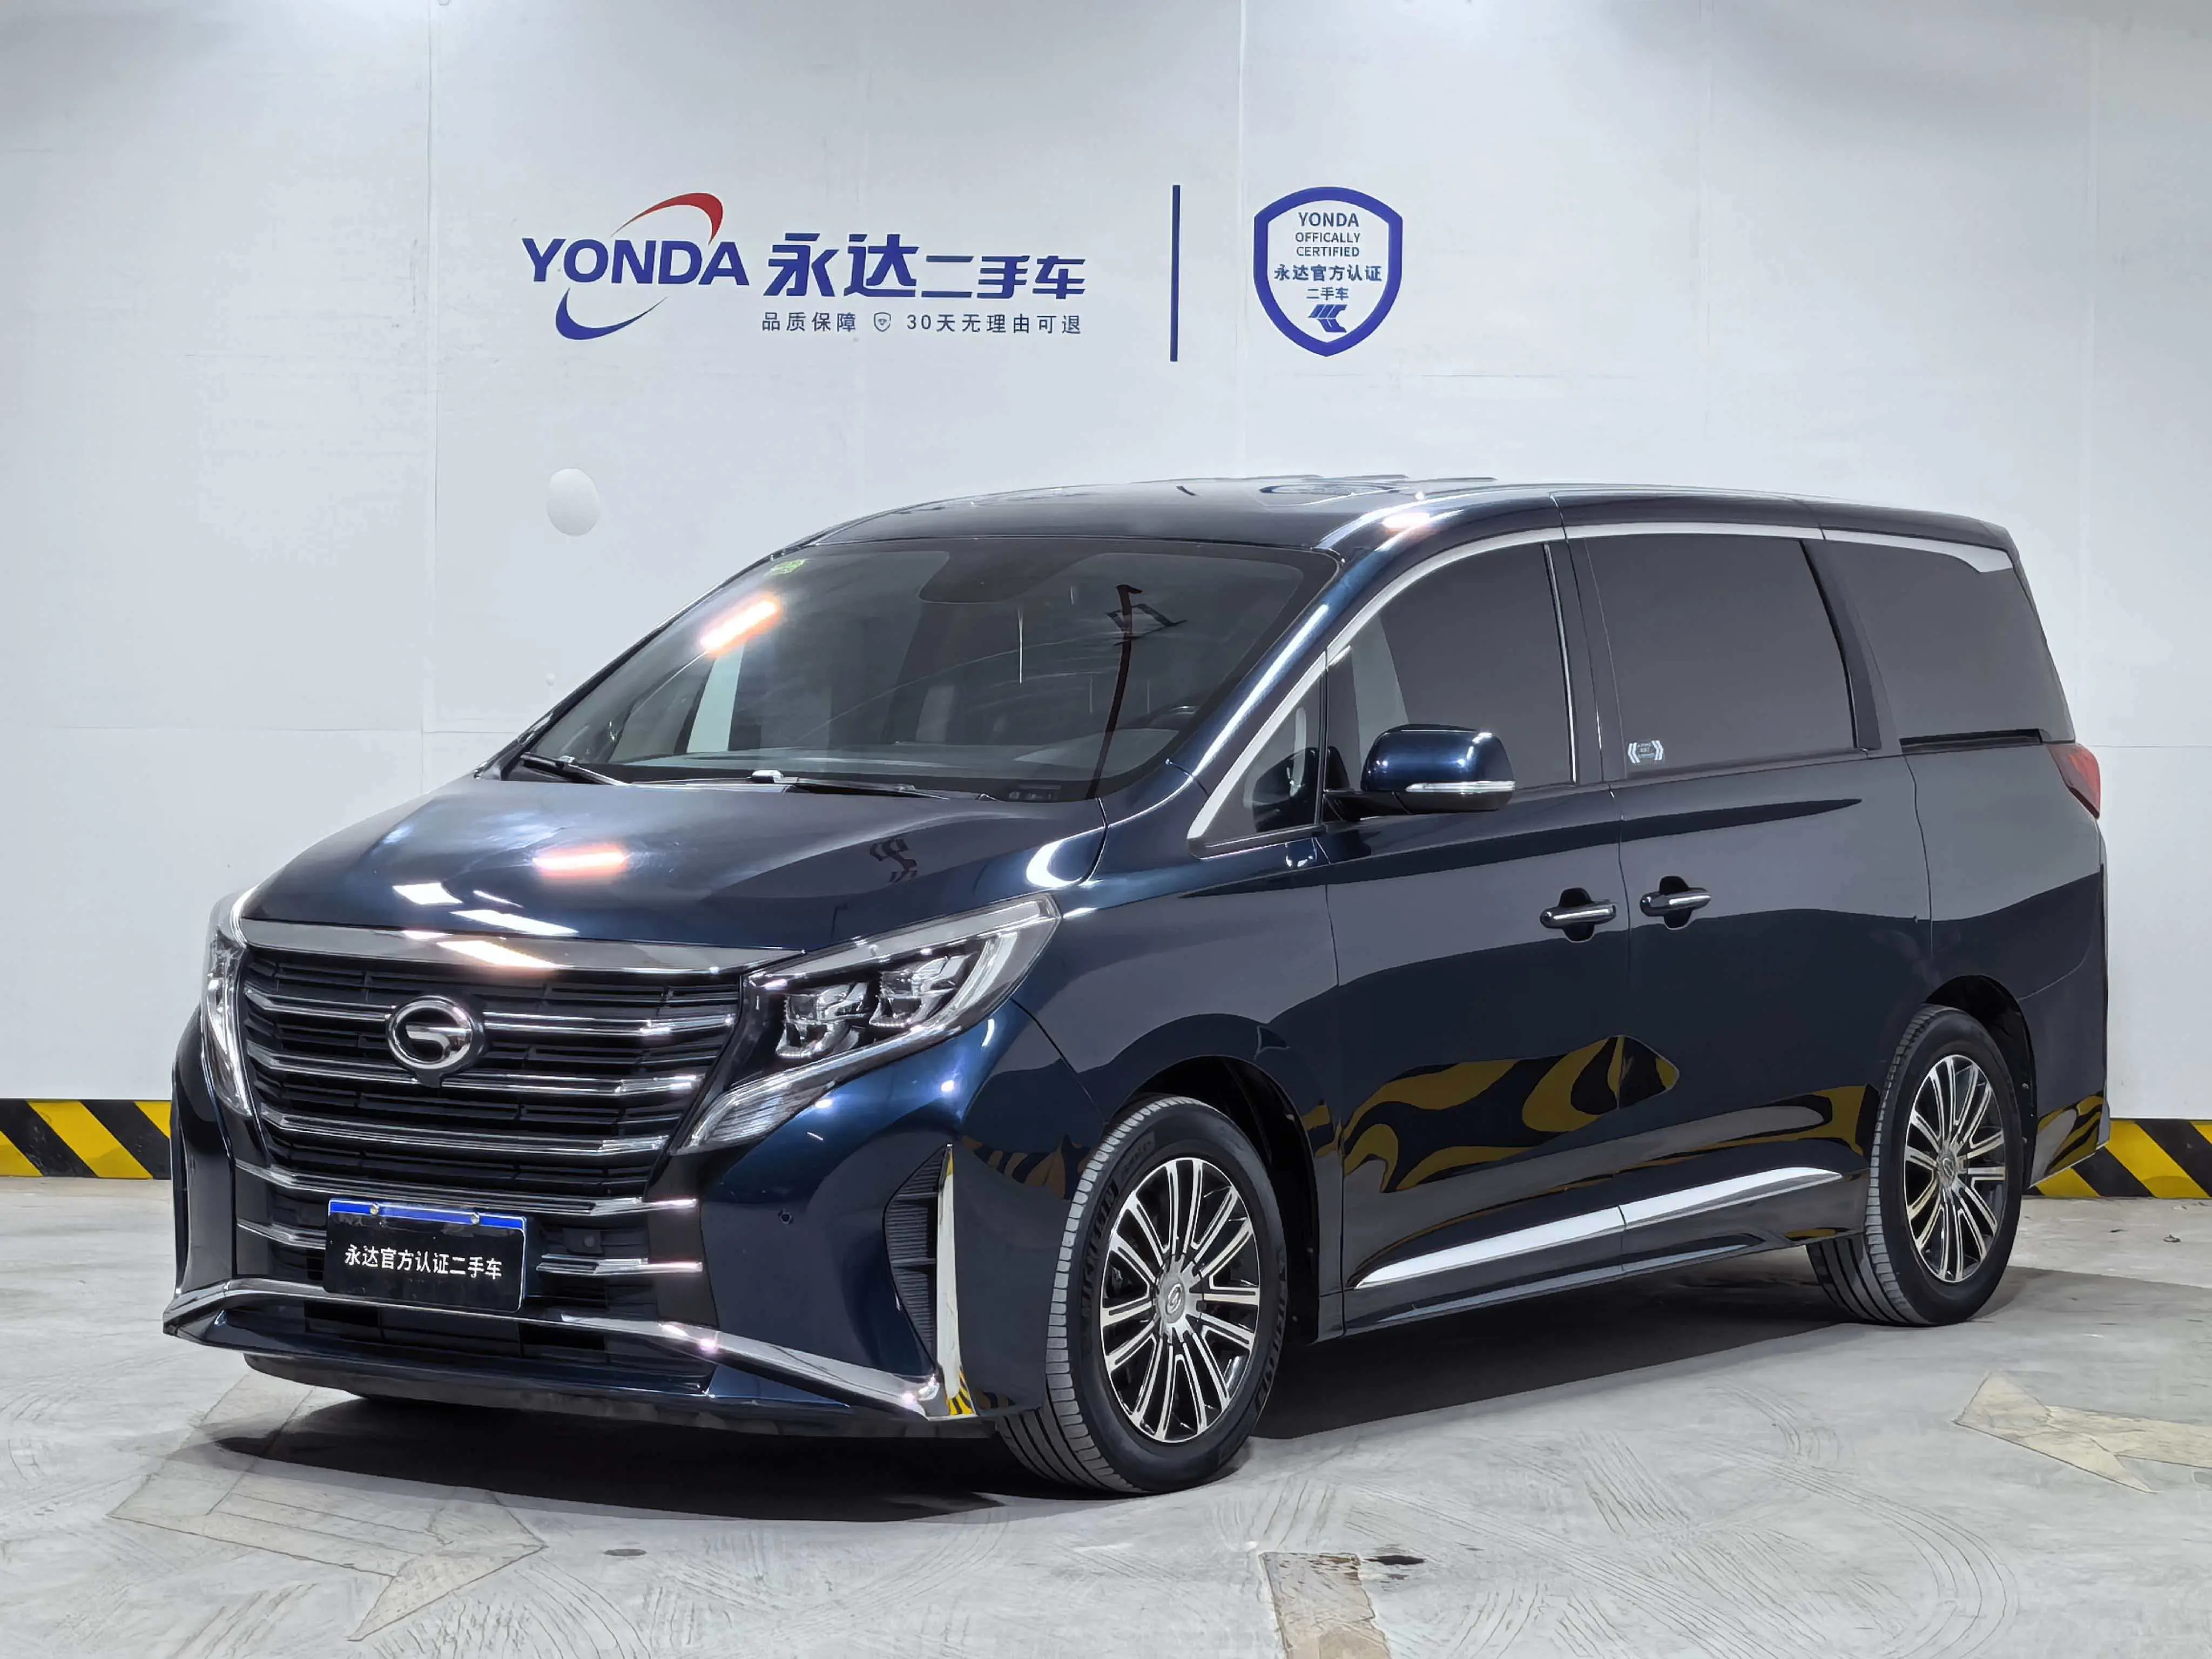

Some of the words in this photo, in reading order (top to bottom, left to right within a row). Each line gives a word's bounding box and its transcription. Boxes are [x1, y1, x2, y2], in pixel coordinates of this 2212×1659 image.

[1298, 212, 1359, 227] YONDA
[1295, 232, 1361, 243] OFFICALLY
[1296, 246, 1360, 257] CERTIFIED
[522, 238, 750, 286] YONDA
[763, 233, 1086, 300] 永达二手车
[1273, 264, 1382, 282] 永达官方认证
[1306, 287, 1349, 301] 二手车
[761, 311, 857, 333] 品质保障
[906, 313, 1082, 335] 30天无理由可退
[344, 1244, 502, 1280] 永达官方认证二手车
